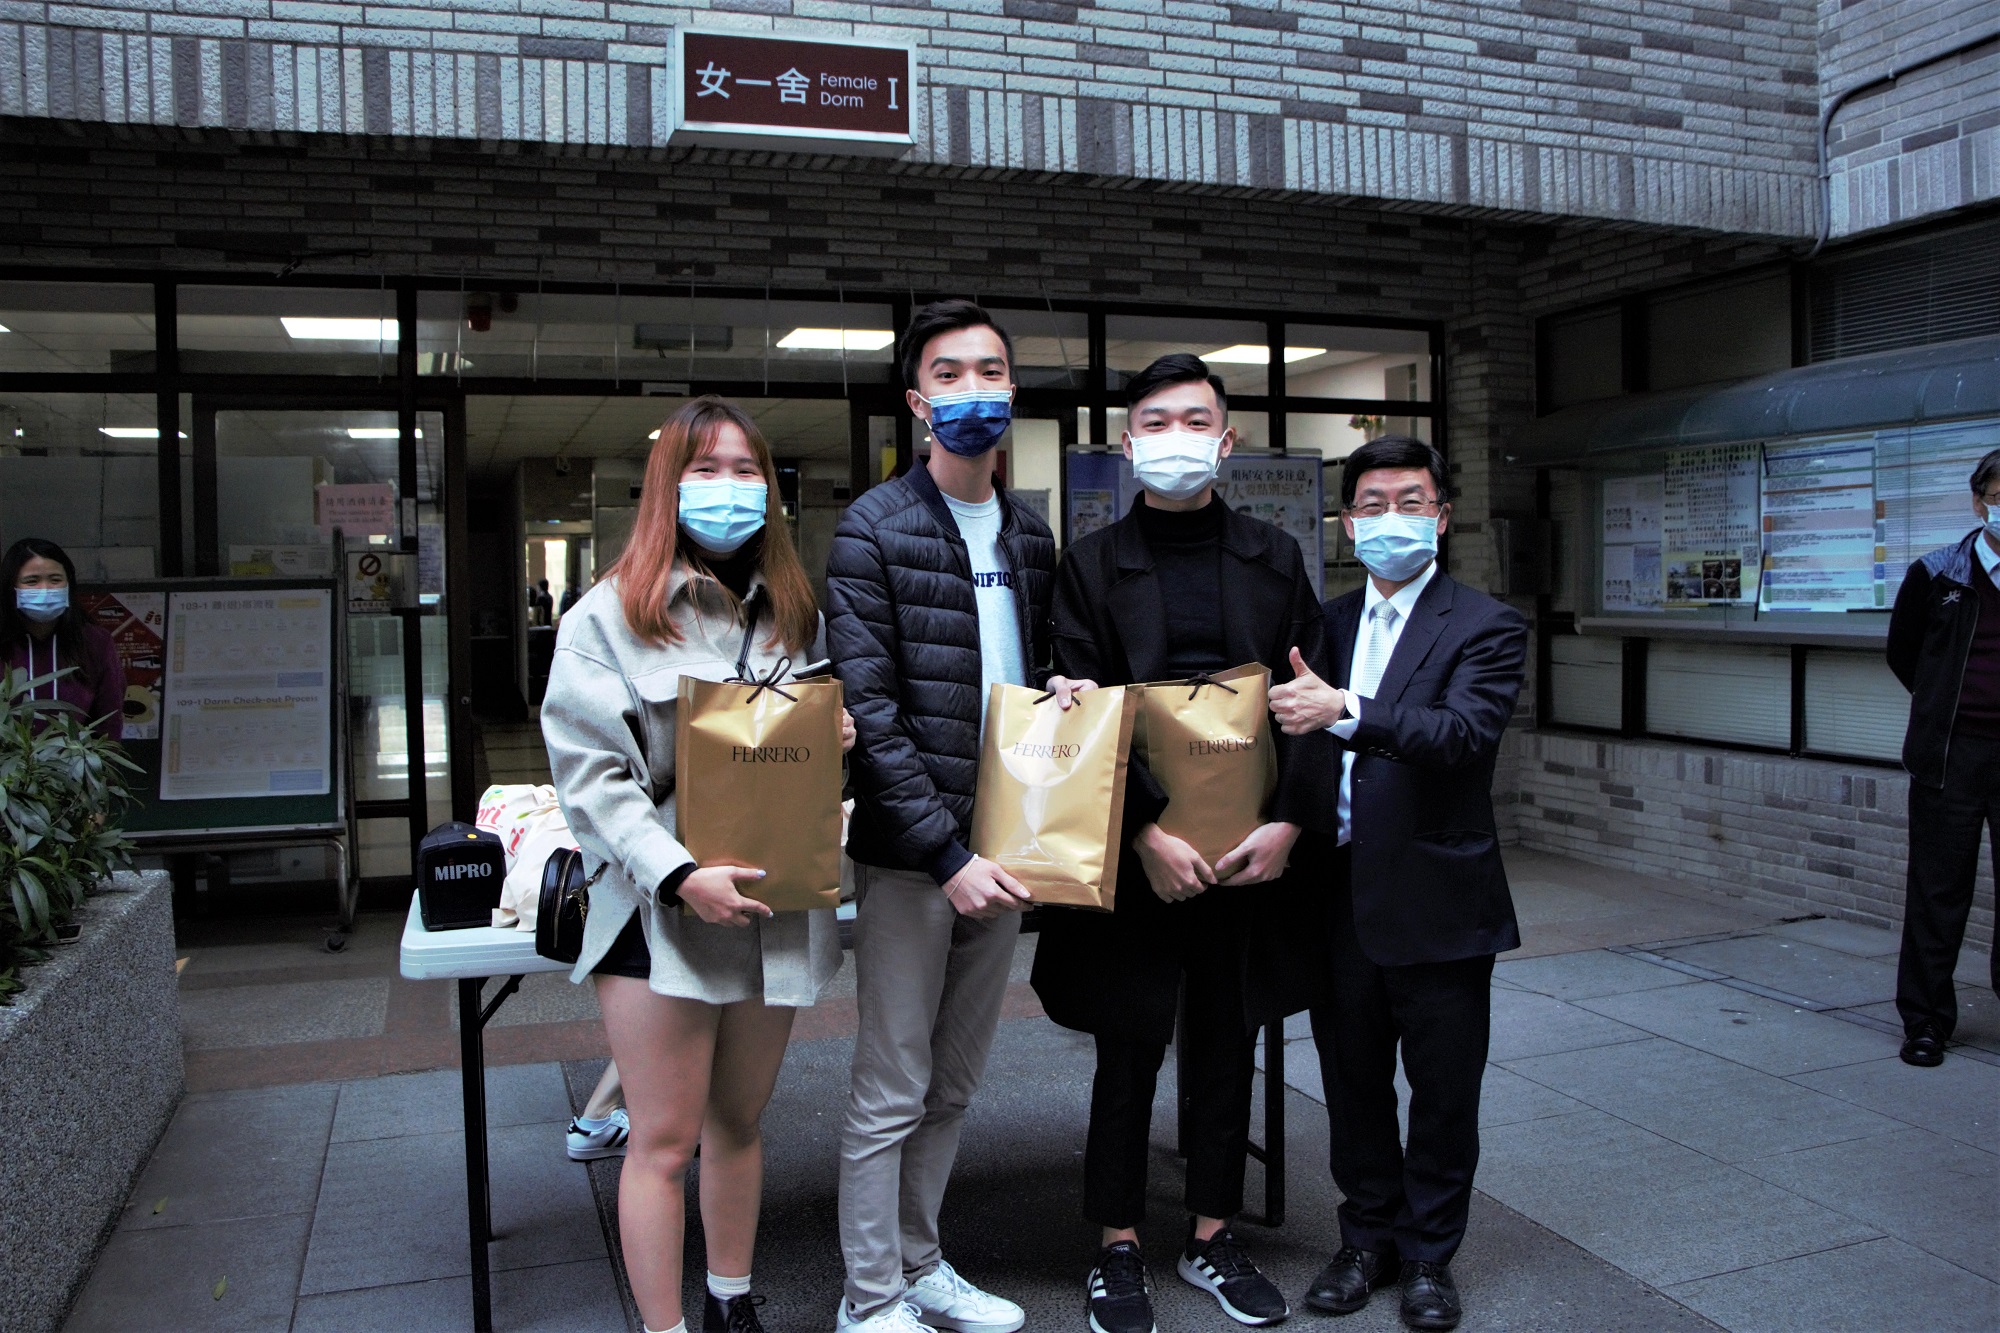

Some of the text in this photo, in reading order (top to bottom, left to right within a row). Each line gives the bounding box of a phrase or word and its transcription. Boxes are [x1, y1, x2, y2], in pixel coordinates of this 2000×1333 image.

[696, 61, 811, 104] 女一舍
[820, 73, 877, 90] Female
[820, 92, 863, 107] Dorm
[234, 696, 282, 704] Check-out
[285, 695, 318, 703] Process
[732, 745, 810, 763] FERRERO
[1013, 742, 1081, 759] FERRERO
[1188, 735, 1258, 756] FERRERO
[434, 862, 492, 881] MIPRO
